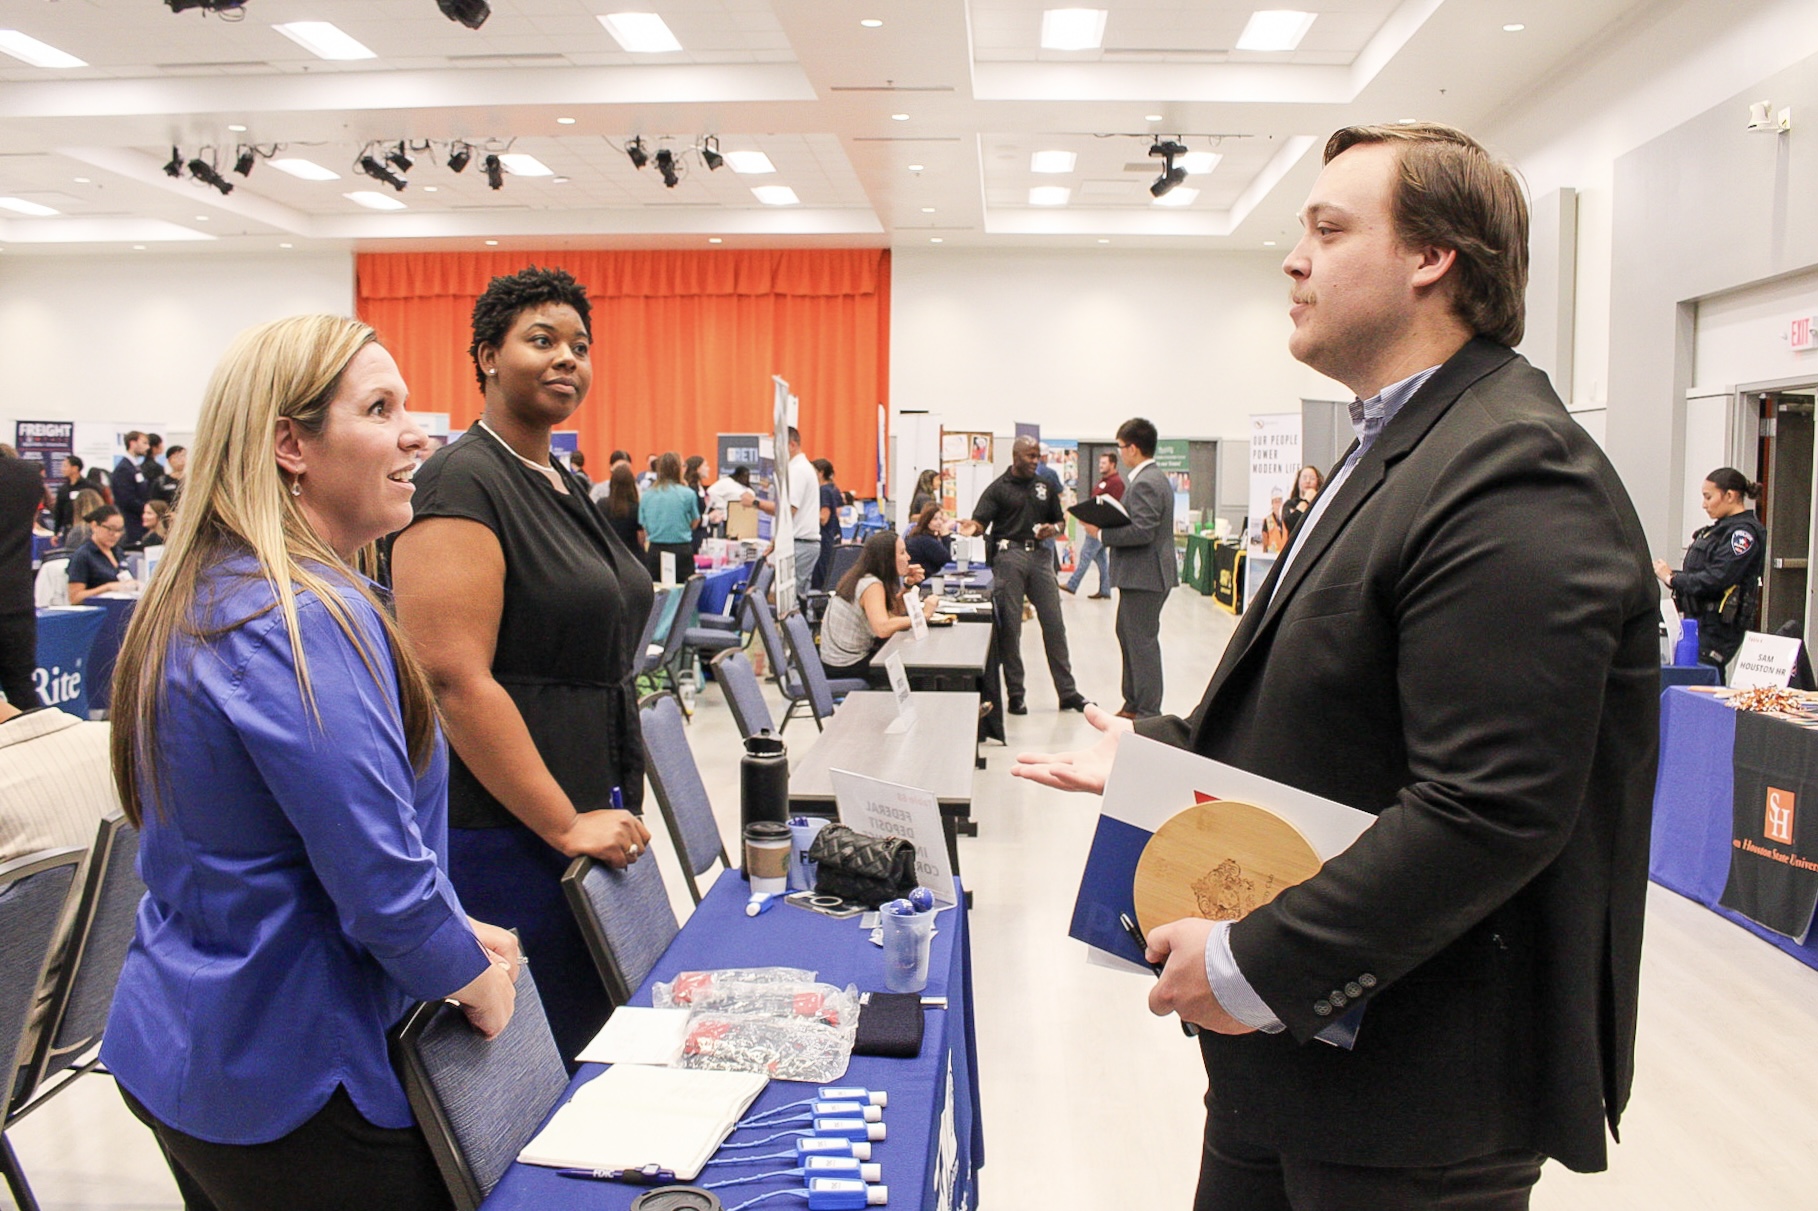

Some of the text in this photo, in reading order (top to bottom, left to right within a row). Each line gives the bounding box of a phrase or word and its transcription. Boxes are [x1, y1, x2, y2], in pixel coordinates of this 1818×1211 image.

[1791, 318, 1810, 347] EXIT
[19, 423, 72, 437] FREIGHT
[1253, 434, 1298, 446] OUR PEOPLE
[1252, 449, 1278, 460] POWER
[1252, 463, 1282, 474] MODERN
[1757, 653, 1775, 662] SAM
[1740, 662, 1787, 676] HOUSTON HR
[1742, 838, 1772, 859] Houston
[1772, 848, 1790, 864] State
